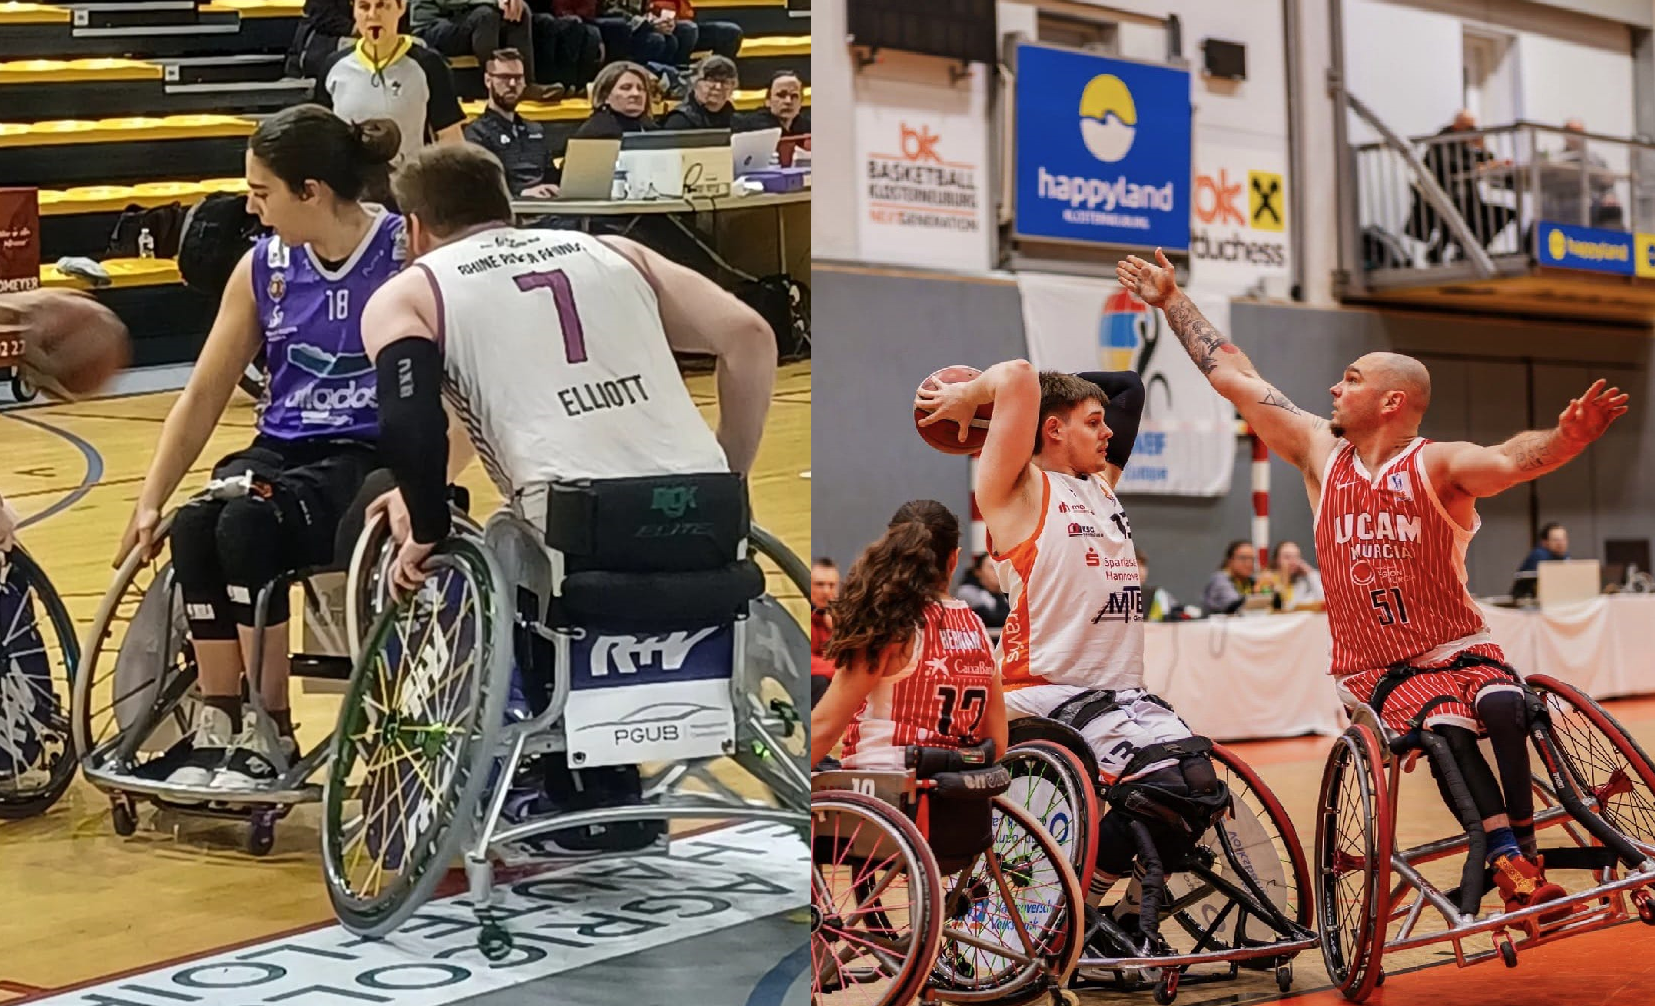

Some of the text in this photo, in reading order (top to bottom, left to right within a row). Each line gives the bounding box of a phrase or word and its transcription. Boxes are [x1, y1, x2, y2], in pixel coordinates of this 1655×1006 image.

[868, 160, 977, 190] BASKETBALL
[1038, 166, 1174, 212] happyland
[325, 289, 349, 321] 18
[511, 268, 588, 364] 7
[557, 373, 649, 417] ELLIOTT
[1335, 511, 1422, 545] UCAM
[1350, 543, 1414, 561] MURCIA
[1370, 587, 1410, 625] 51
[590, 625, 720, 677] R+V
[614, 724, 680, 745] PGUB
[215, 872, 796, 1006] AGRICOL
